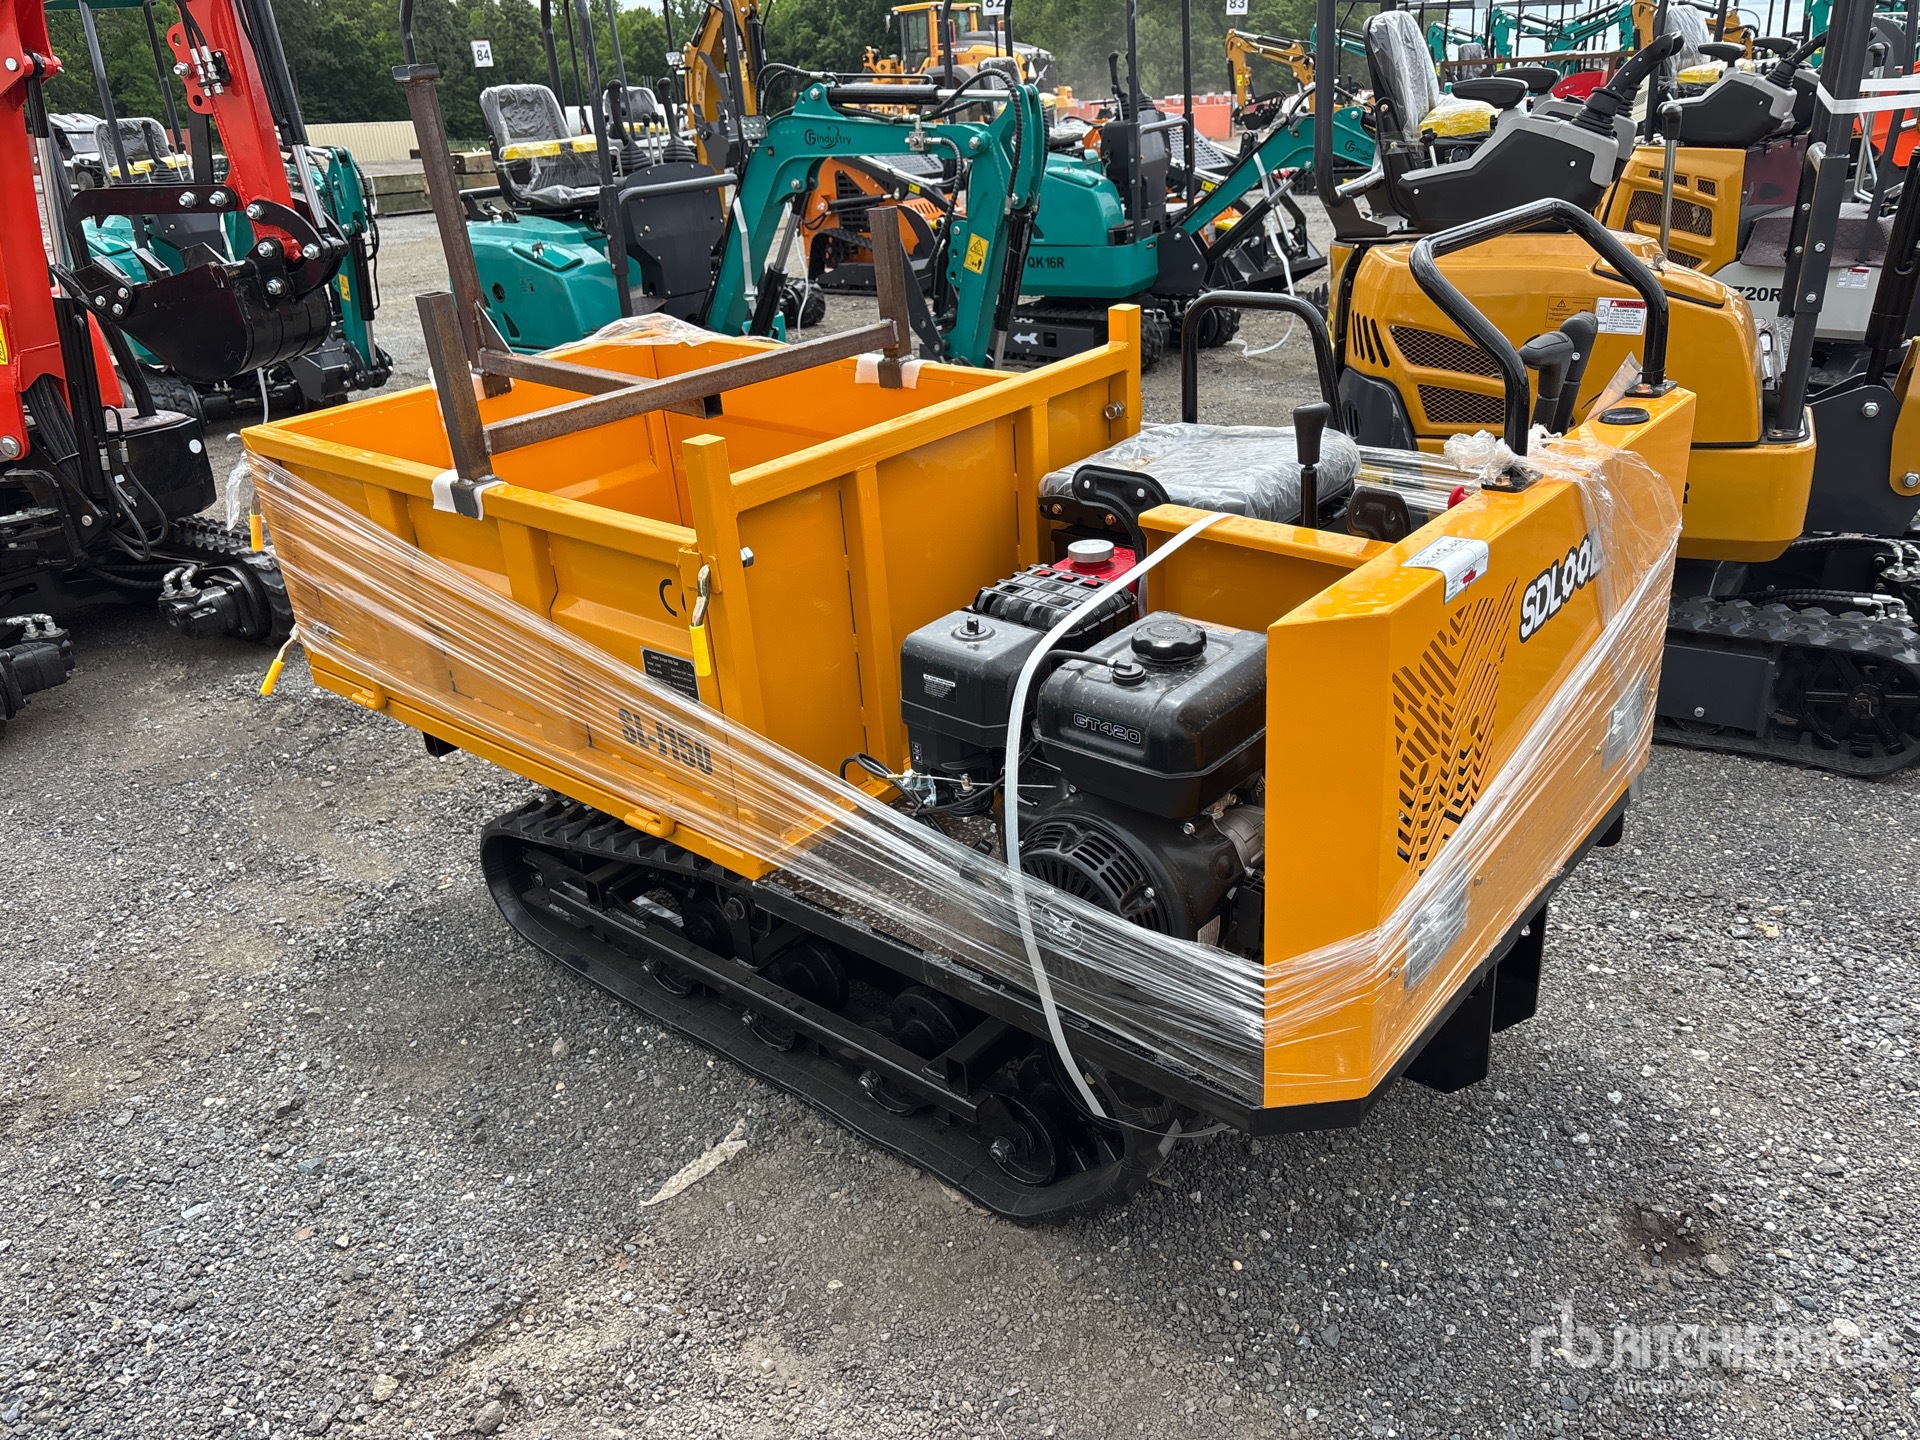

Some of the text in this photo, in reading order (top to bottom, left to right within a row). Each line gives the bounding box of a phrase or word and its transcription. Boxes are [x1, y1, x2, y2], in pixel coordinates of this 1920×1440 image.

[986, 0, 1005, 8] 82
[1229, 0, 1245, 9] 83
[476, 49, 490, 61] 84
[1073, 713, 1141, 744] GT420
